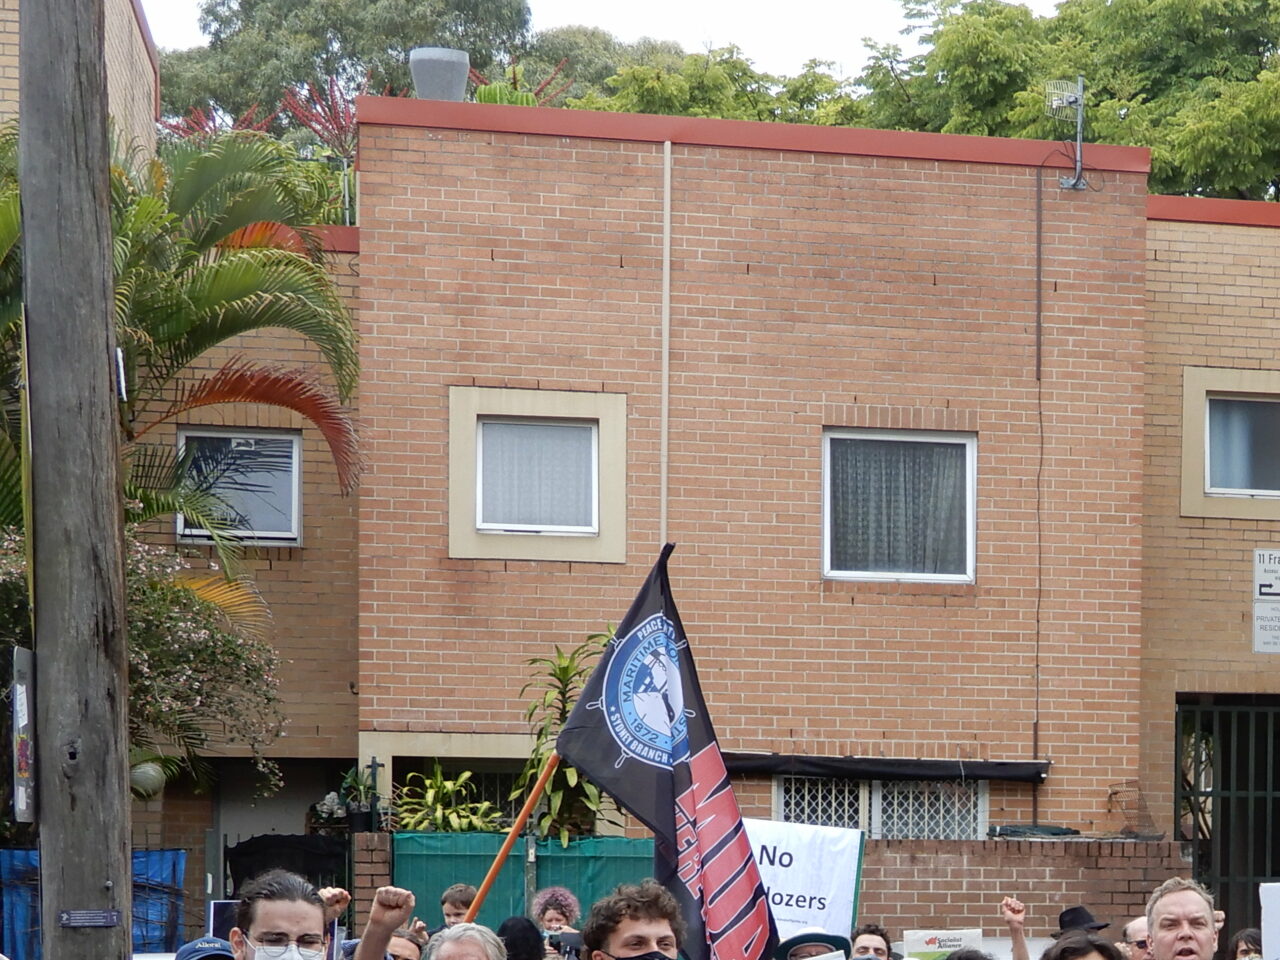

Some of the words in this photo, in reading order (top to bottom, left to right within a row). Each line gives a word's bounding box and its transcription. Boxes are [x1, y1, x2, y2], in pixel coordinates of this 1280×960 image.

[1258, 553, 1265, 564] 11
[637, 618, 663, 641] PEACE
[623, 635, 664, 703] MARITIME
[610, 713, 633, 747] SYDNEY
[631, 740, 668, 764] BRANCH
[630, 718, 660, 743] 1872
[759, 844, 794, 868] No
